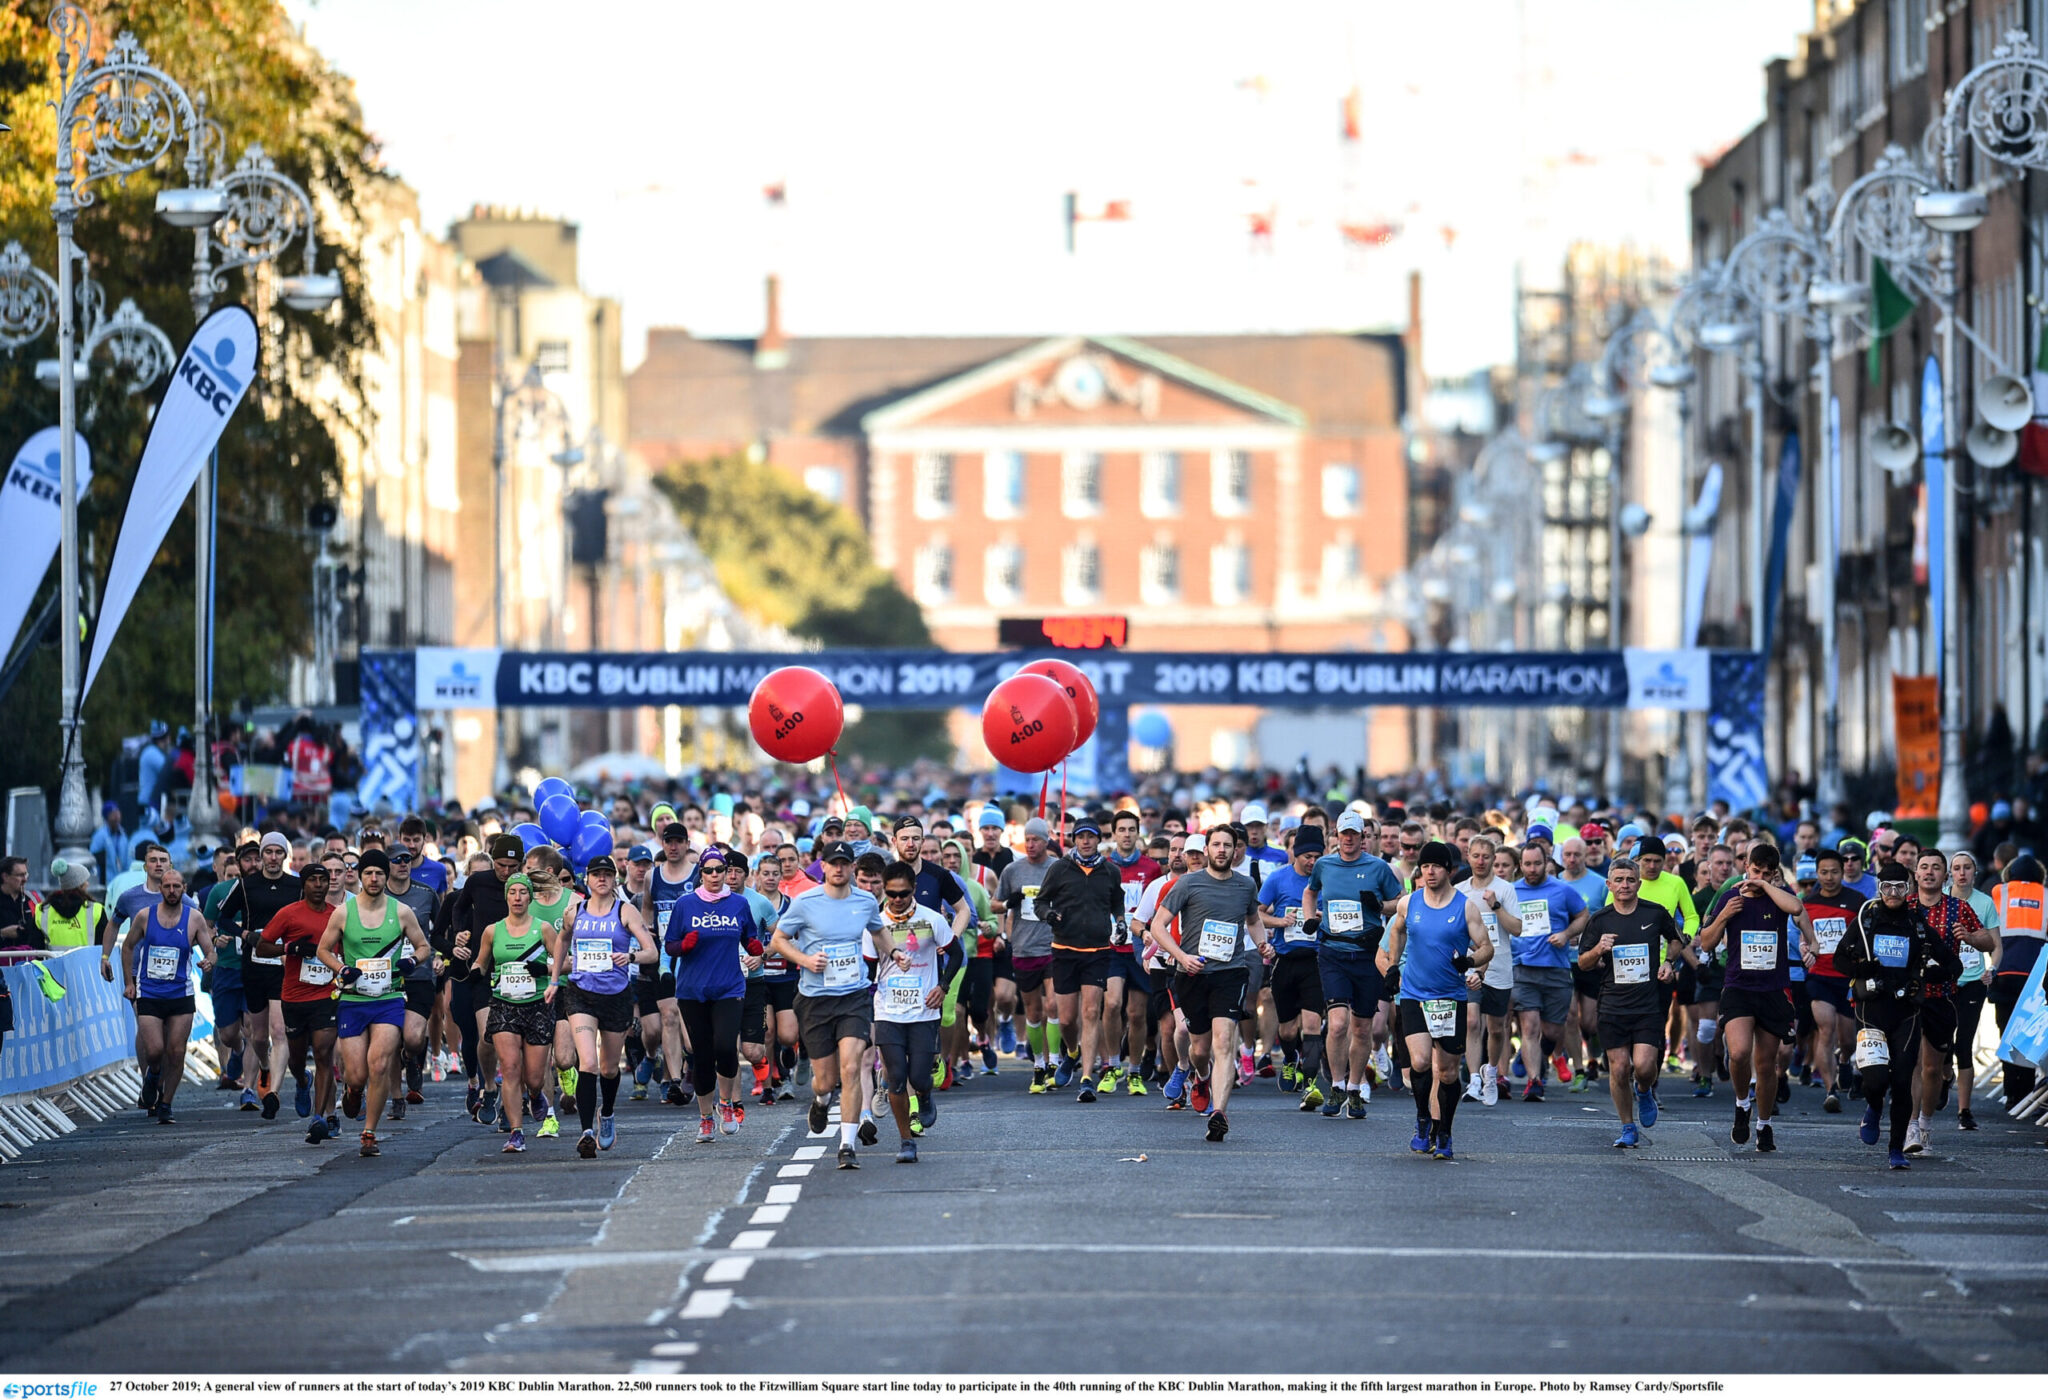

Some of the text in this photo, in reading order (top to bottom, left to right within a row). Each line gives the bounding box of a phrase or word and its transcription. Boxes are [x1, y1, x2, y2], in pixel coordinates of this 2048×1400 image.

[178, 356, 232, 417] KBC
[520, 663, 592, 694] KBC
[598, 663, 719, 694] DUBLIN
[722, 664, 892, 694] MAHON
[900, 664, 974, 694] 2019
[1154, 662, 1231, 693] 2019
[1237, 661, 1310, 693] KBC
[1314, 661, 1436, 693] DUBLIN
[1441, 664, 1610, 694] MARATHON
[774, 711, 804, 740] 4:00
[1010, 720, 1044, 745] 4:00
[692, 911, 738, 928] DEBRA
[1334, 912, 1359, 920] 15034
[1524, 912, 1543, 920] 8519
[576, 920, 618, 932] CATHY
[1206, 934, 1233, 944] 13950
[582, 952, 608, 960] 21153
[1878, 948, 1903, 957] MARK
[830, 957, 856, 968] 11654
[1618, 958, 1646, 966] 10931
[307, 965, 331, 974] 14314
[364, 972, 386, 980] 3450
[505, 976, 532, 984] 10295
[892, 989, 919, 998] 14072
[1861, 1040, 1883, 1048] 4691
